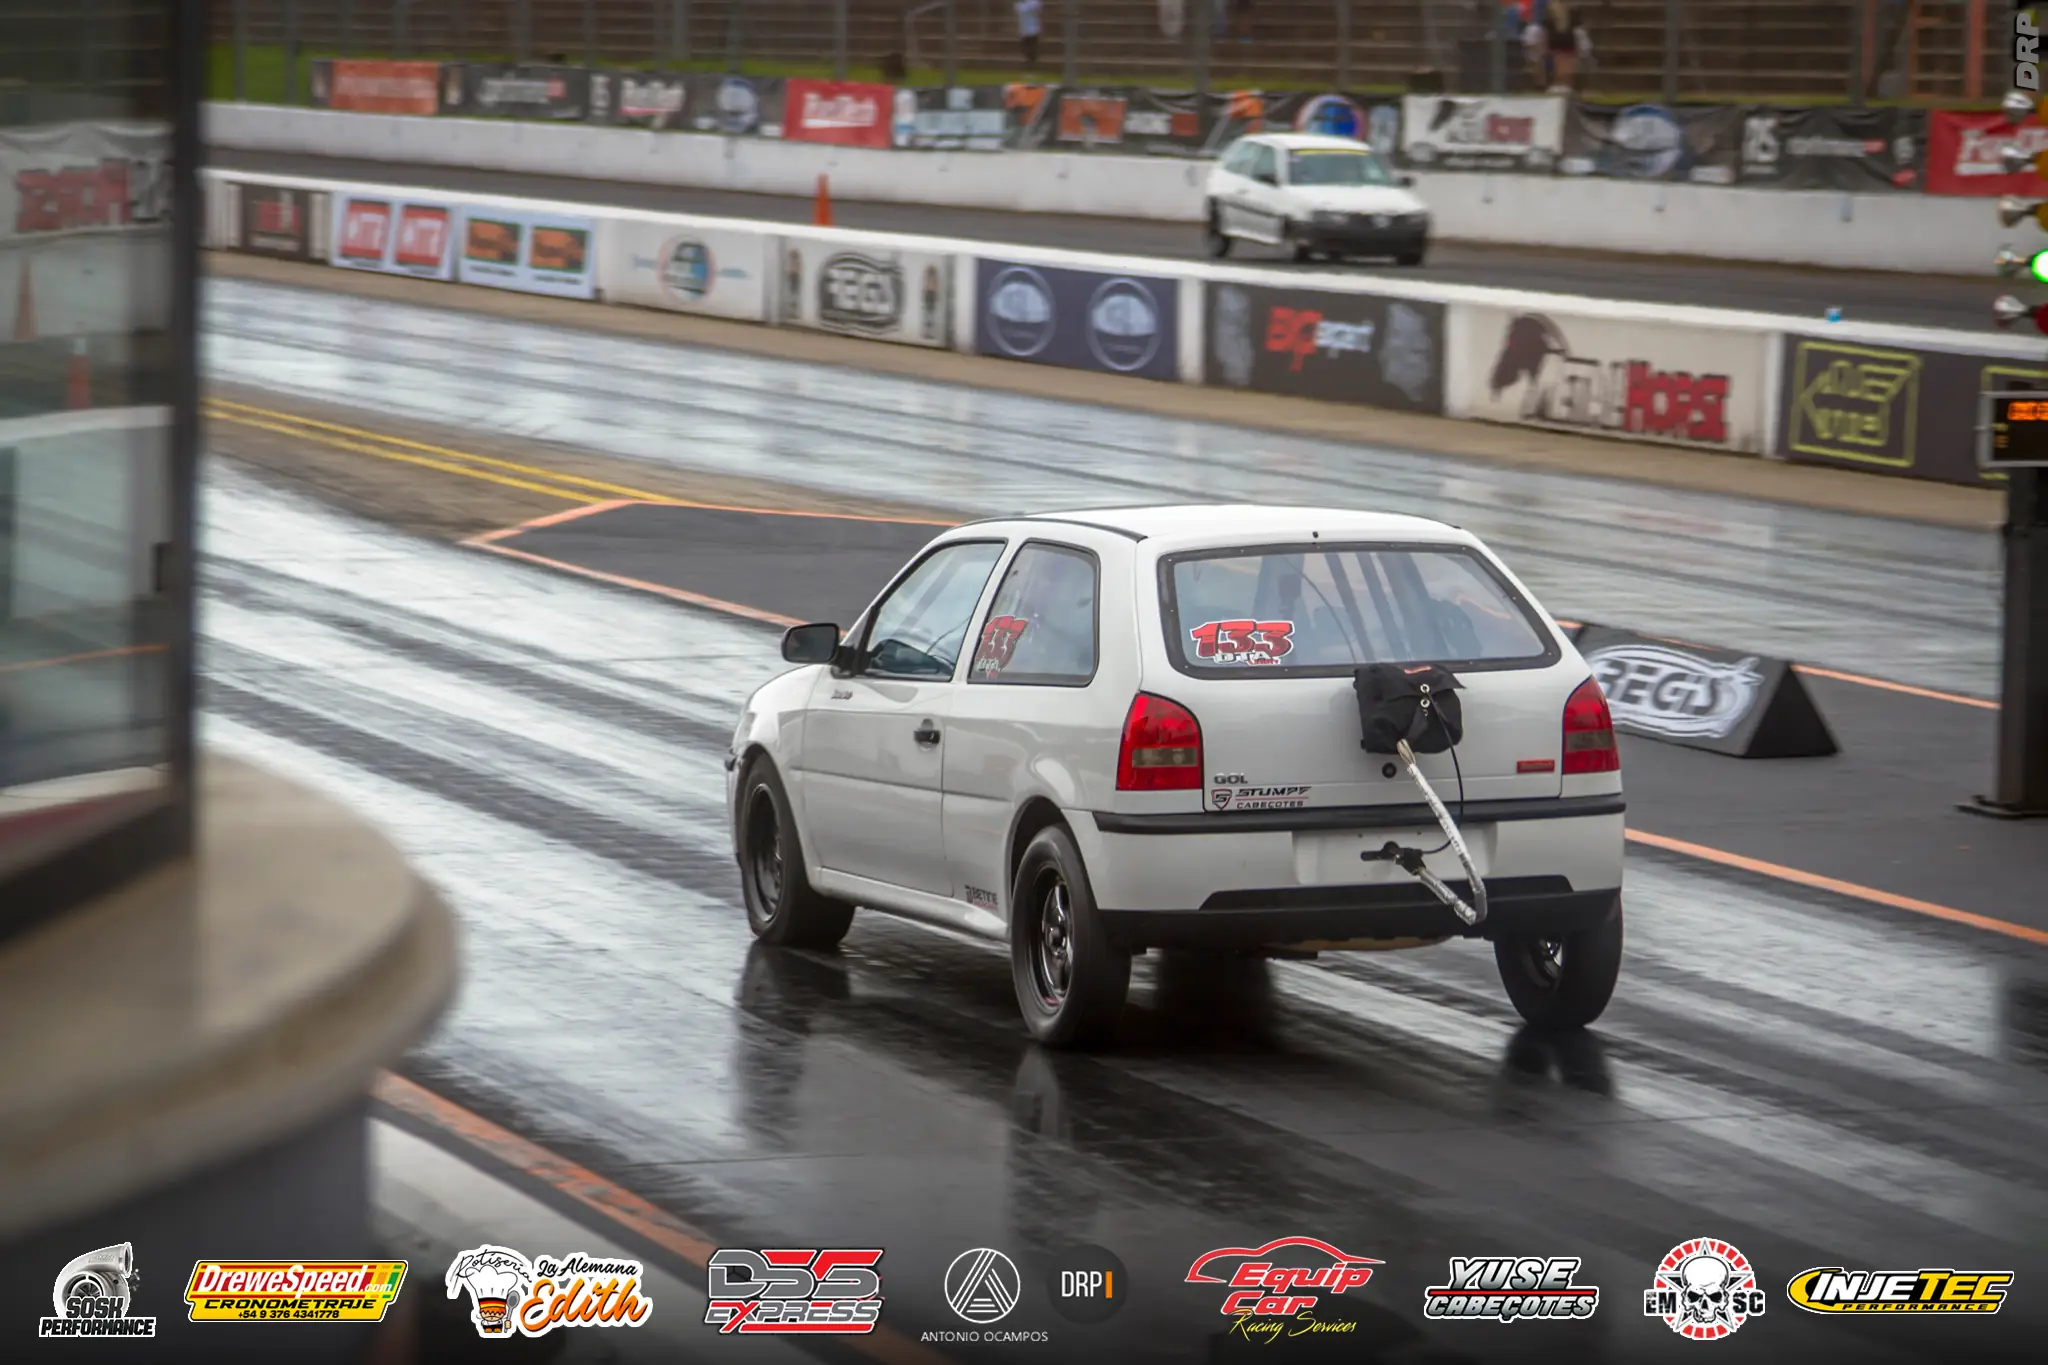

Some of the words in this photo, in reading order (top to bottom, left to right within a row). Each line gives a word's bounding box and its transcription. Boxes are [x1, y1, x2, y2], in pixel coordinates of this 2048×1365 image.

[1190, 619, 1294, 658] 133
[1214, 773, 1248, 784] GOL
[1235, 786, 1312, 797] STUMPF
